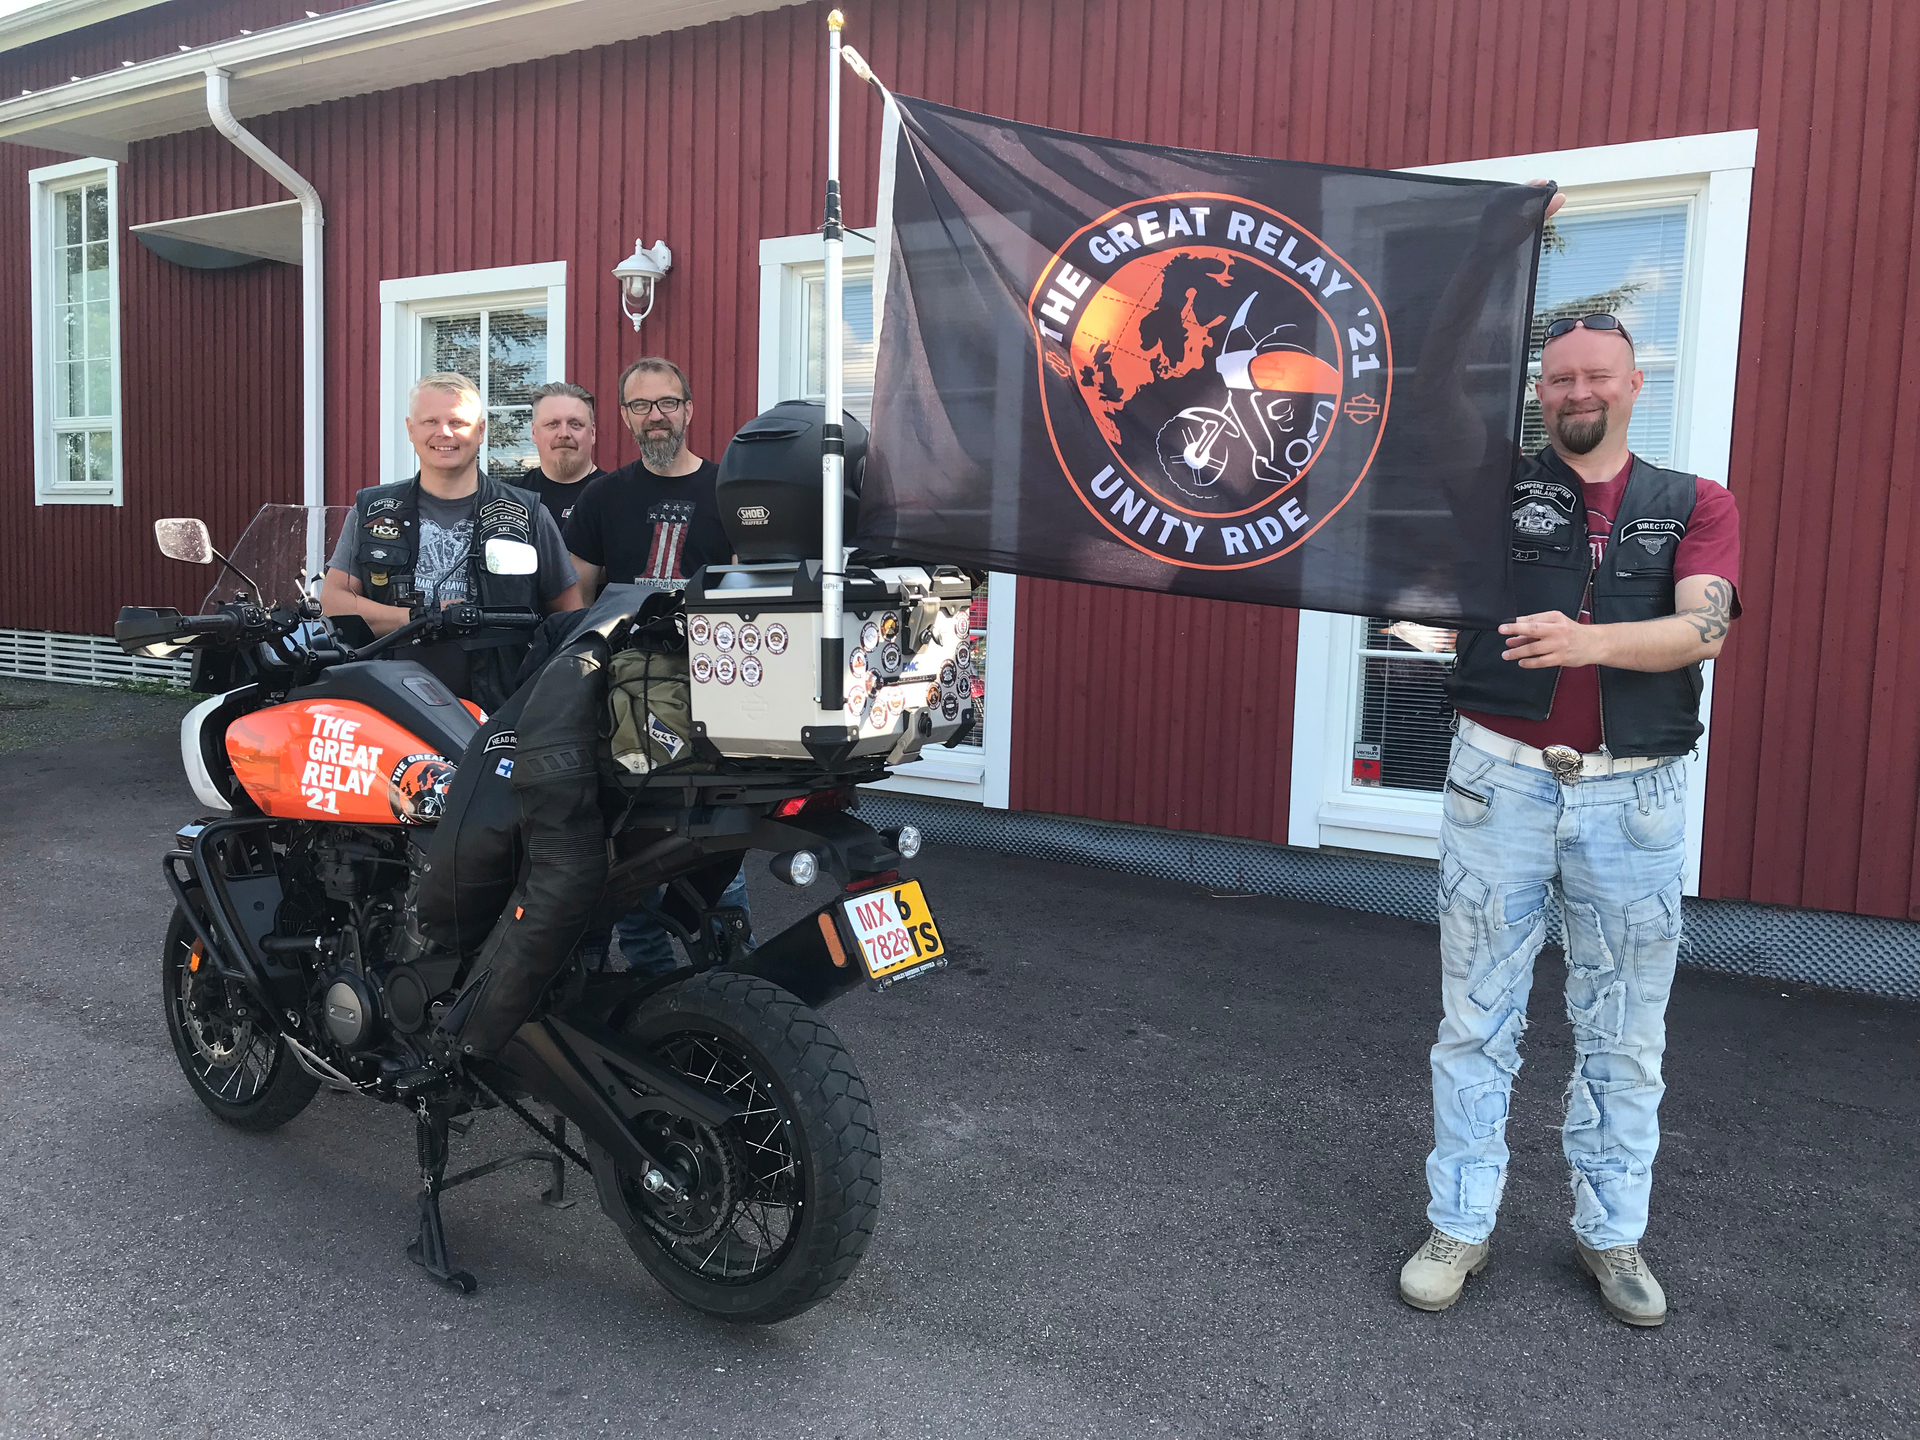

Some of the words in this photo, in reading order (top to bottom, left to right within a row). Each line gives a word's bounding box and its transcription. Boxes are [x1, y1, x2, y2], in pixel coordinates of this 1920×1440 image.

[1039, 262, 1092, 342] THE
[1088, 206, 1211, 264] GREAT
[1227, 210, 1354, 299] RELAY
[1347, 307, 1381, 379] '21
[1516, 483, 1544, 492] TAMPERE
[1545, 485, 1572, 500] CHAPTER
[1529, 489, 1557, 498] FINLAND
[499, 514, 527, 527] CAPTAIN
[740, 508, 765, 519] SHOEI
[1090, 464, 1205, 553] UNITY
[1219, 496, 1310, 556] RIDE
[1636, 522, 1676, 530] DIRECTOR
[312, 713, 362, 741] THE
[492, 736, 510, 746] HEAD
[308, 736, 384, 772] GREAT
[391, 761, 408, 782] THE
[407, 754, 446, 764] GREAT
[301, 760, 377, 796] RELAY
[300, 785, 341, 815] '21
[855, 897, 893, 932] MX
[865, 928, 910, 964] 7828
[907, 922, 939, 957] TS
